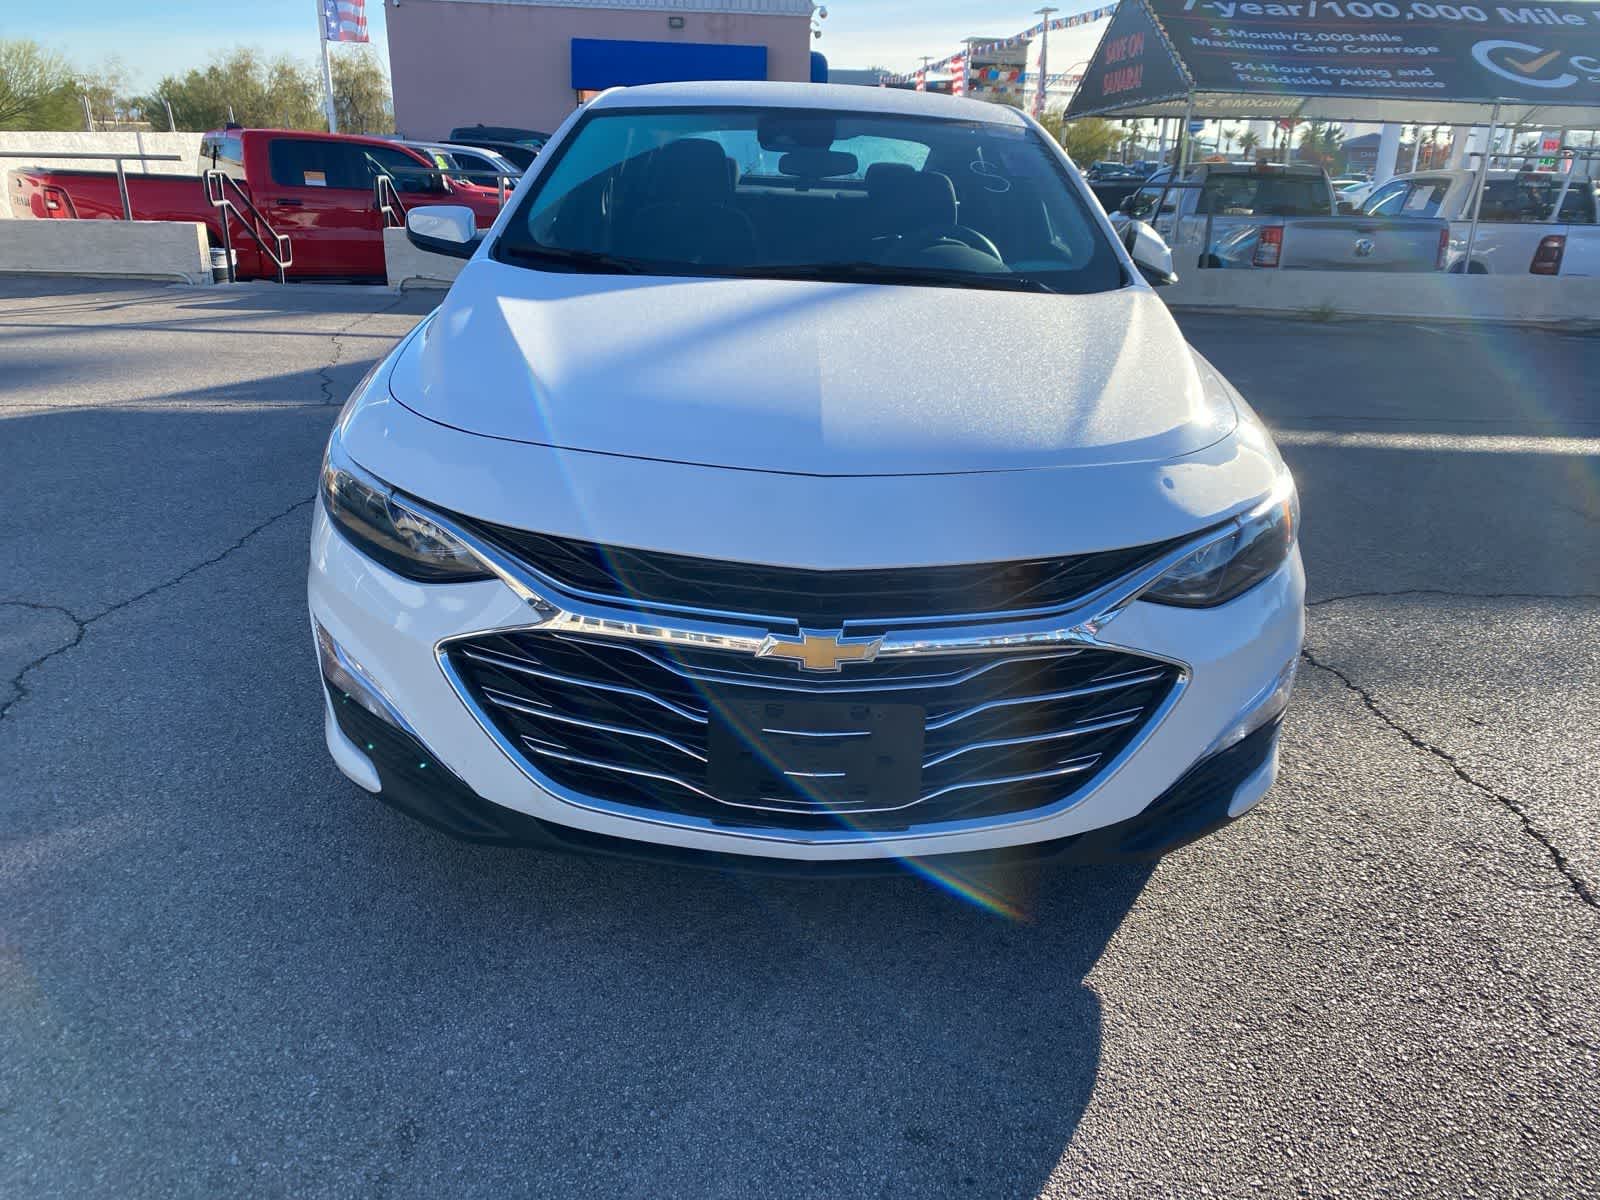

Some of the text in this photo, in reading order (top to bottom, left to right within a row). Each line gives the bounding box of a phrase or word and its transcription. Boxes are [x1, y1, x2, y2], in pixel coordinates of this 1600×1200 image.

[1496, 7, 1586, 26] Mile
[1210, 27, 1403, 43] 3-Month/3,000-Mile
[1128, 31, 1145, 58] ON
[1191, 37, 1440, 56] Maximum Care Coverage
[1231, 61, 1435, 79] 24-Hour Towing and
[1236, 73, 1447, 89] Roadside Assistance
